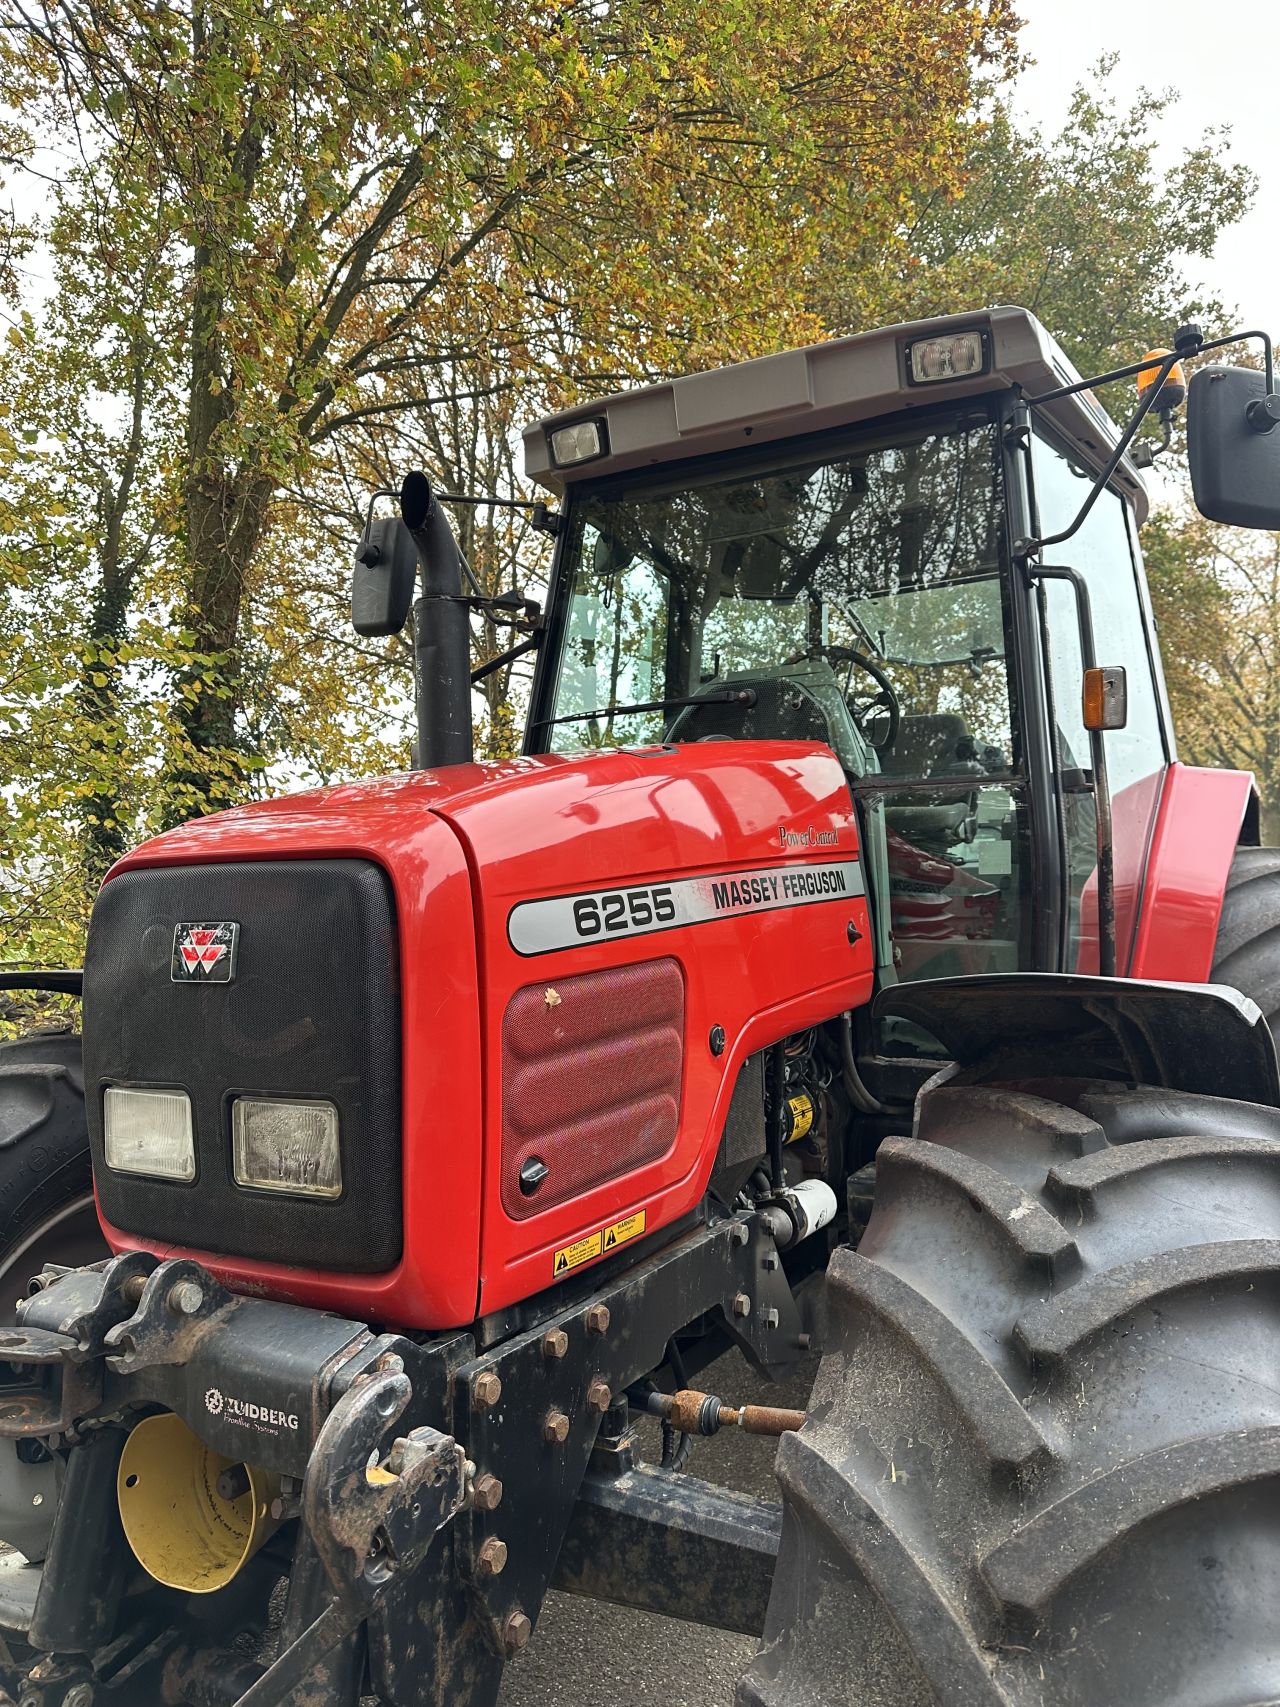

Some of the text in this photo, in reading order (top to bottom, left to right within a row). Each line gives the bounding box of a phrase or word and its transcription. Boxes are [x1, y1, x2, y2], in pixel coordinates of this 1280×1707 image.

[779, 825, 839, 848] PowerControl
[573, 870, 846, 936] 6255 MASSEY FERGUSON
[569, 1238, 590, 1253] CAUTION
